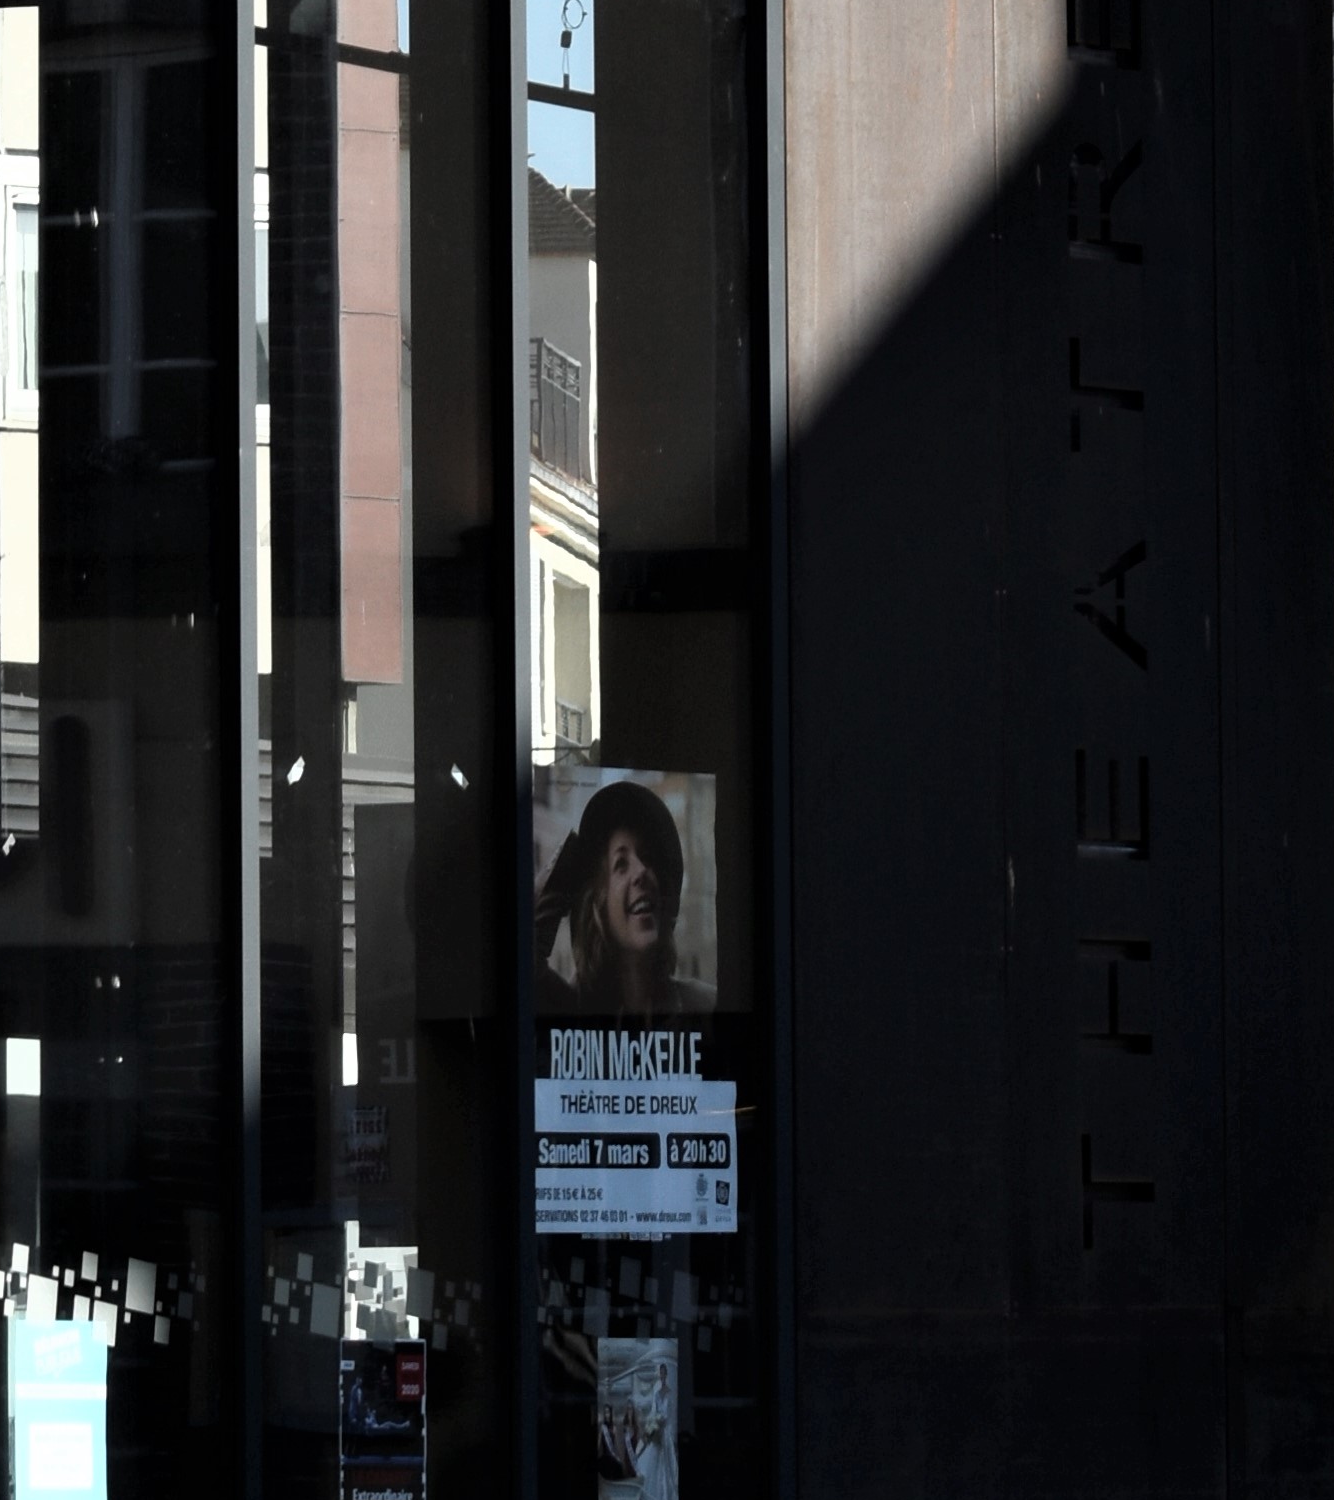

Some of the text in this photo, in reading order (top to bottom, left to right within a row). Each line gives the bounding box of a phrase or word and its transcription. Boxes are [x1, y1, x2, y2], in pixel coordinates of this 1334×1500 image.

[550, 1028, 703, 1081] ROBIN McKELLE
[624, 1095, 646, 1115] DE
[650, 1096, 698, 1115] DREUX
[538, 1137, 591, 1165] Samedi
[592, 1138, 604, 1165] 7
[607, 1143, 650, 1165] mars
[670, 1138, 679, 1163] à
